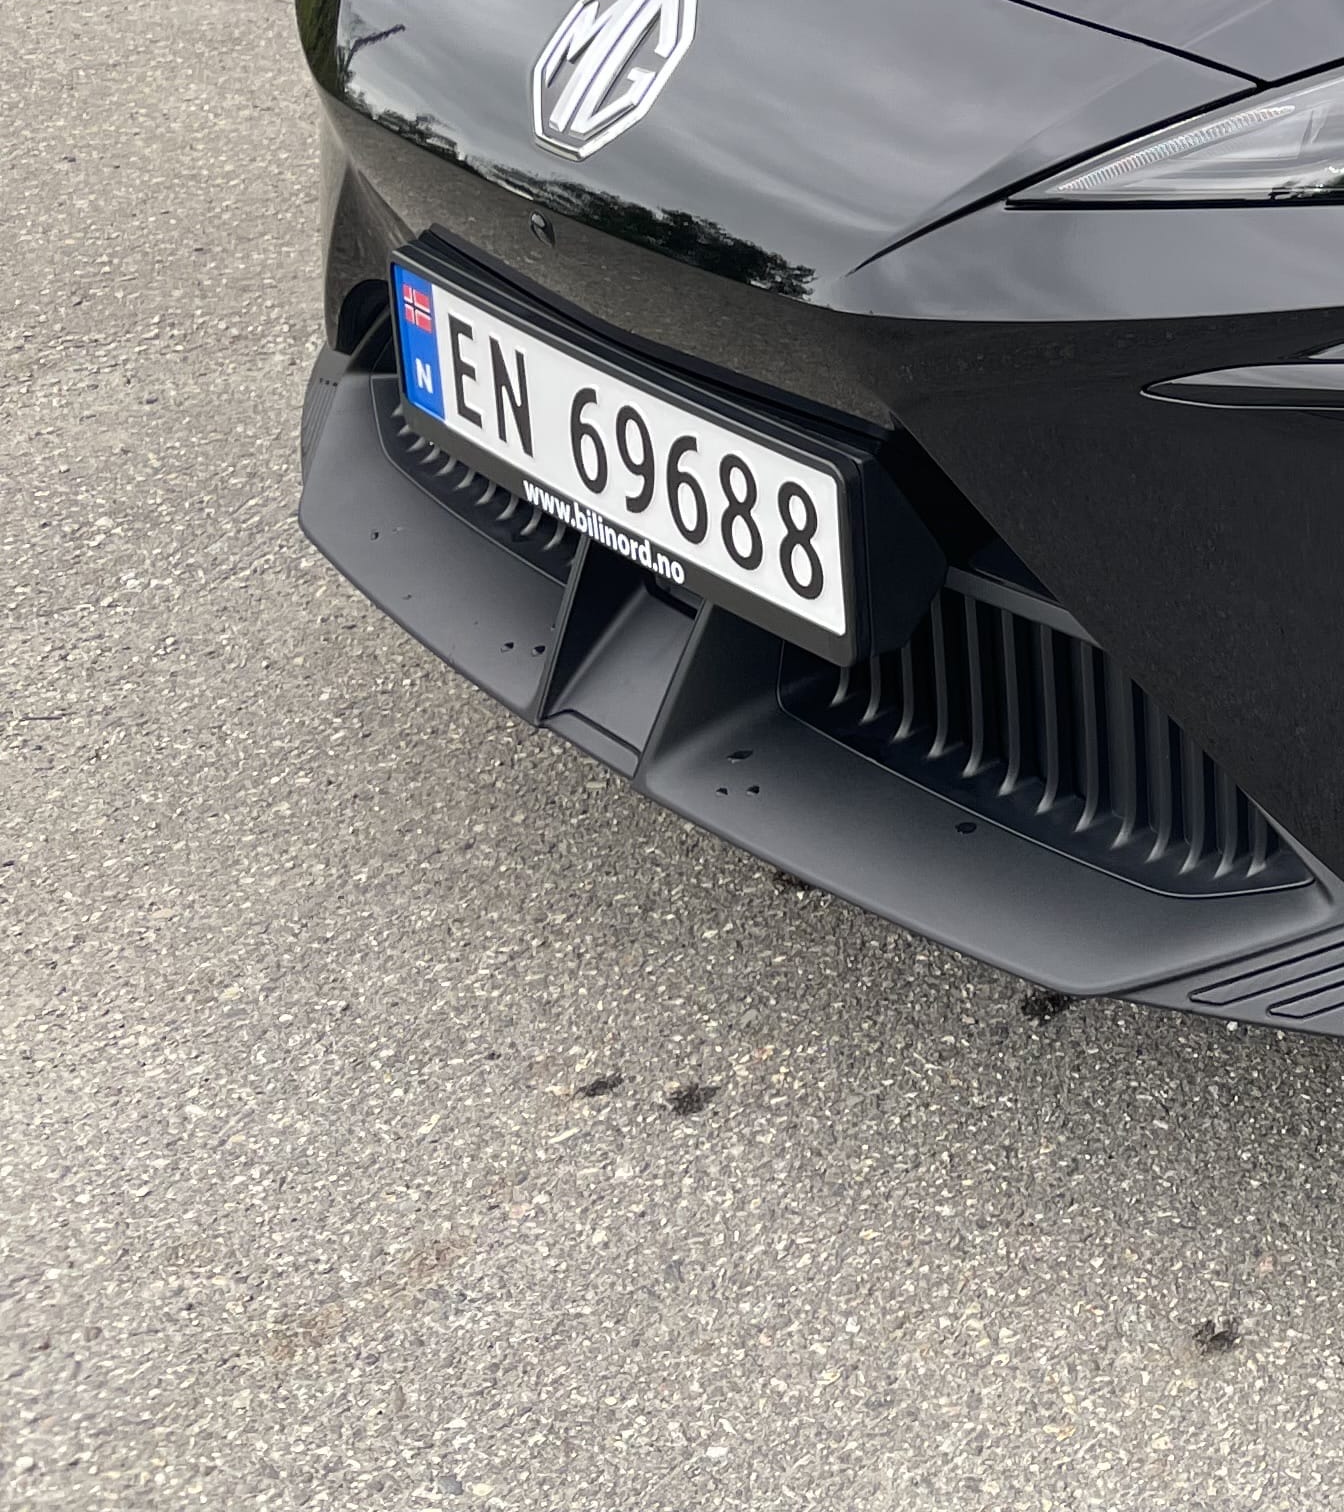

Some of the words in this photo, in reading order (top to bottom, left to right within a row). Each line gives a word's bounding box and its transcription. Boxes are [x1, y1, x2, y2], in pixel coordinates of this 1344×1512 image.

[415, 358, 434, 395] N
[448, 312, 534, 459] EN
[569, 387, 824, 600] 69688
[522, 478, 686, 585] www.bilinord.no
